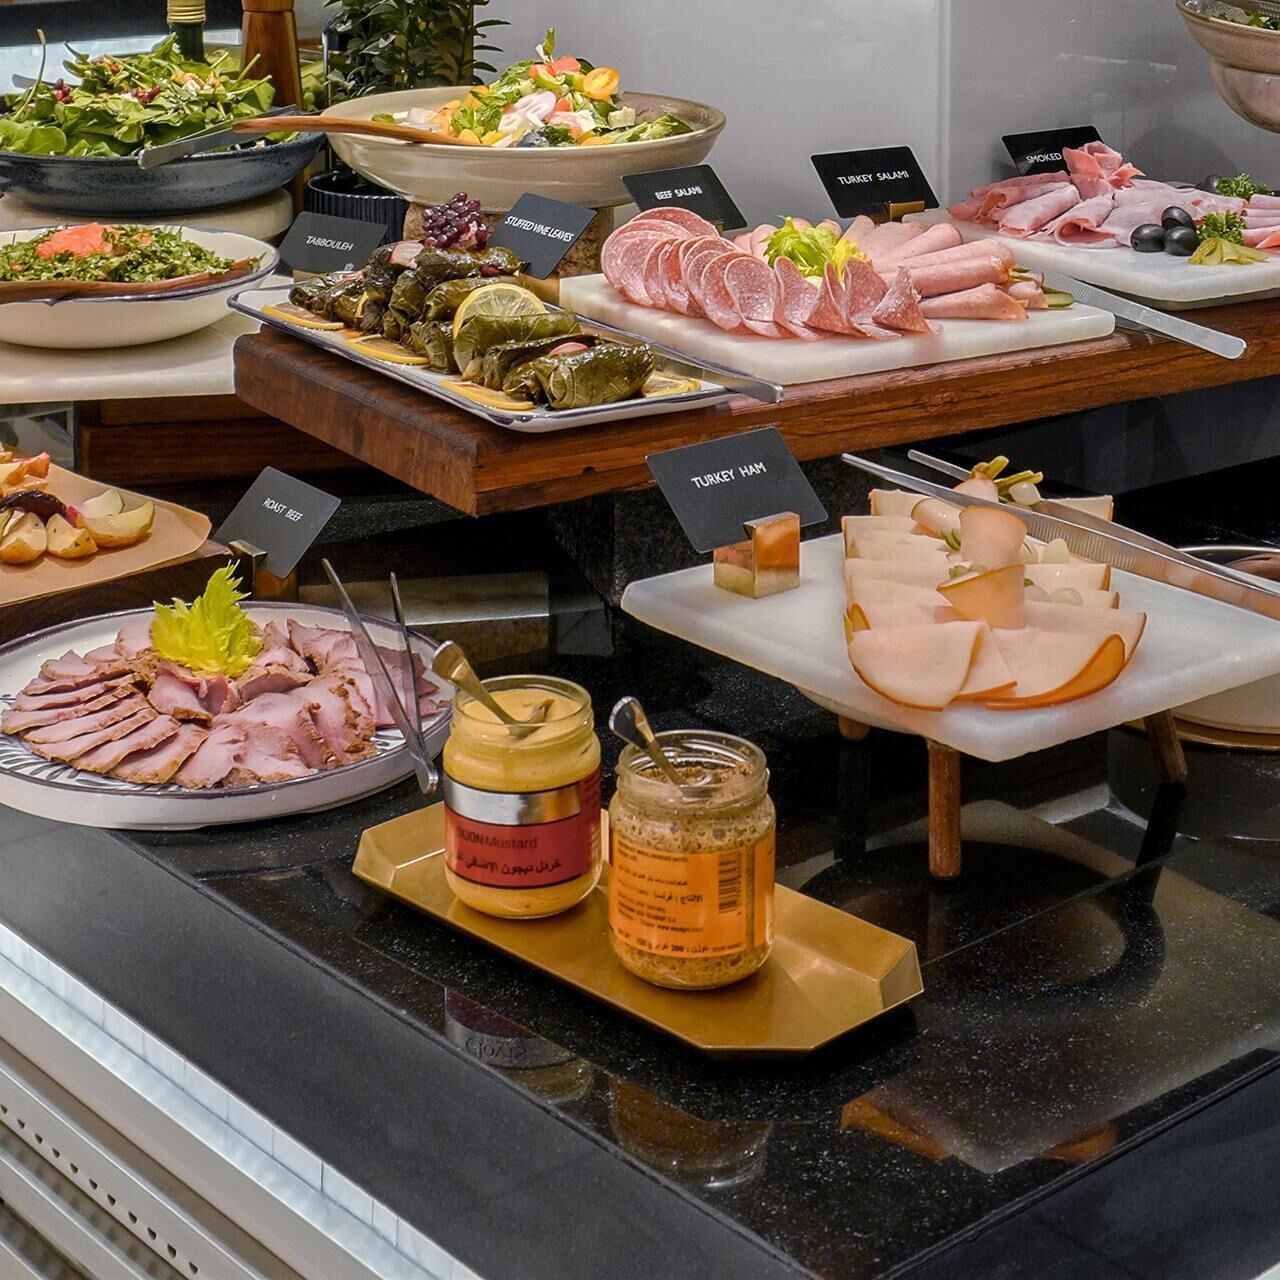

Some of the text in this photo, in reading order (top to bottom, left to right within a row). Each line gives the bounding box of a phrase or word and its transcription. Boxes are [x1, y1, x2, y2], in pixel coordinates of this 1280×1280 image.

[1025, 152, 1062, 164] SMOKED
[837, 169, 910, 185] TURKEY SALAMI
[654, 185, 703, 200] BEEF SALAMI
[504, 215, 575, 242] STUFFED VINE LEAVES
[306, 235, 354, 251] TABBOULEH
[690, 461, 767, 489] TURKEY HAM
[262, 497, 304, 522] ROAST BEEF
[485, 836, 538, 850] Mustard
